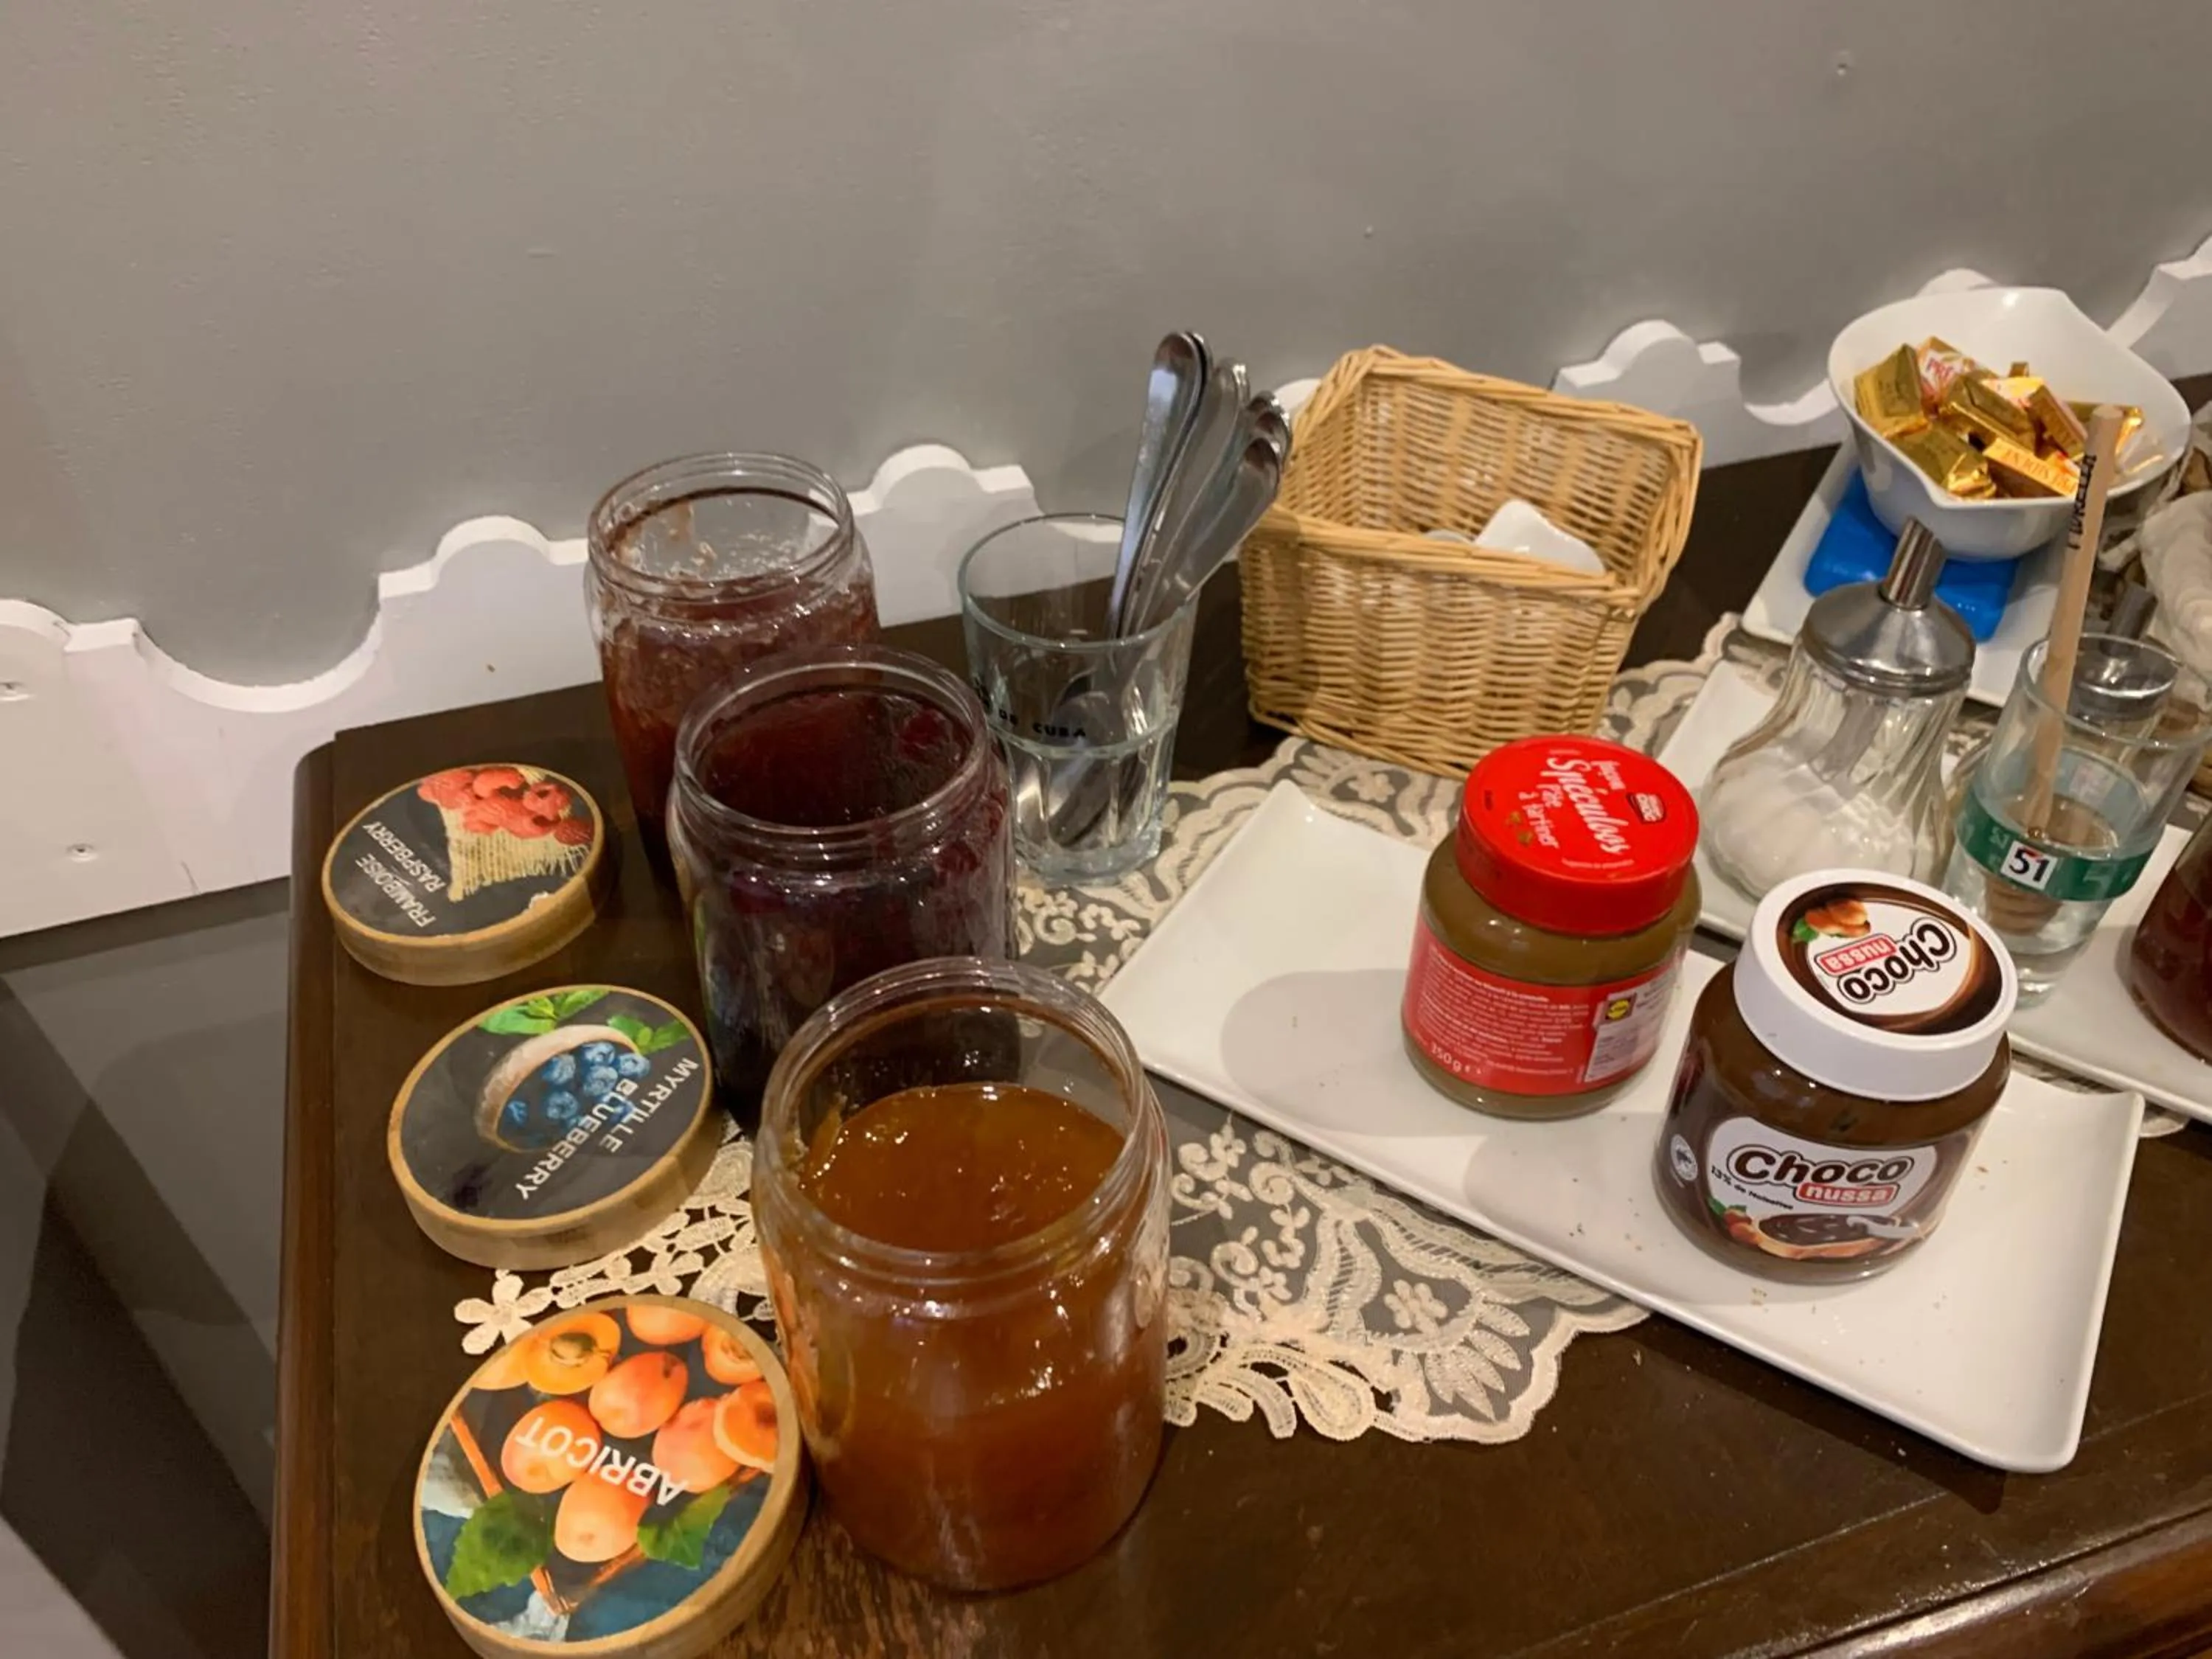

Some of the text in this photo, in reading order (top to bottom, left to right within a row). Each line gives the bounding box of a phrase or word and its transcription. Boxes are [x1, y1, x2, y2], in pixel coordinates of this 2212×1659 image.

[1540, 757, 1632, 855] Spéculoos
[355, 853, 437, 928] FRAMBOISE
[362, 820, 447, 894] RASPBERRY
[2007, 847, 2053, 883] 51
[1821, 940, 1896, 970] nussa
[1842, 922, 1952, 1001] Choco
[515, 1077, 639, 1200] BLUEBERRY
[599, 1056, 700, 1152] MYRTILLE
[1733, 1150, 1911, 1184] Choco
[1805, 1184, 1892, 1203] nussa
[514, 1416, 690, 1506] ABRICOT
